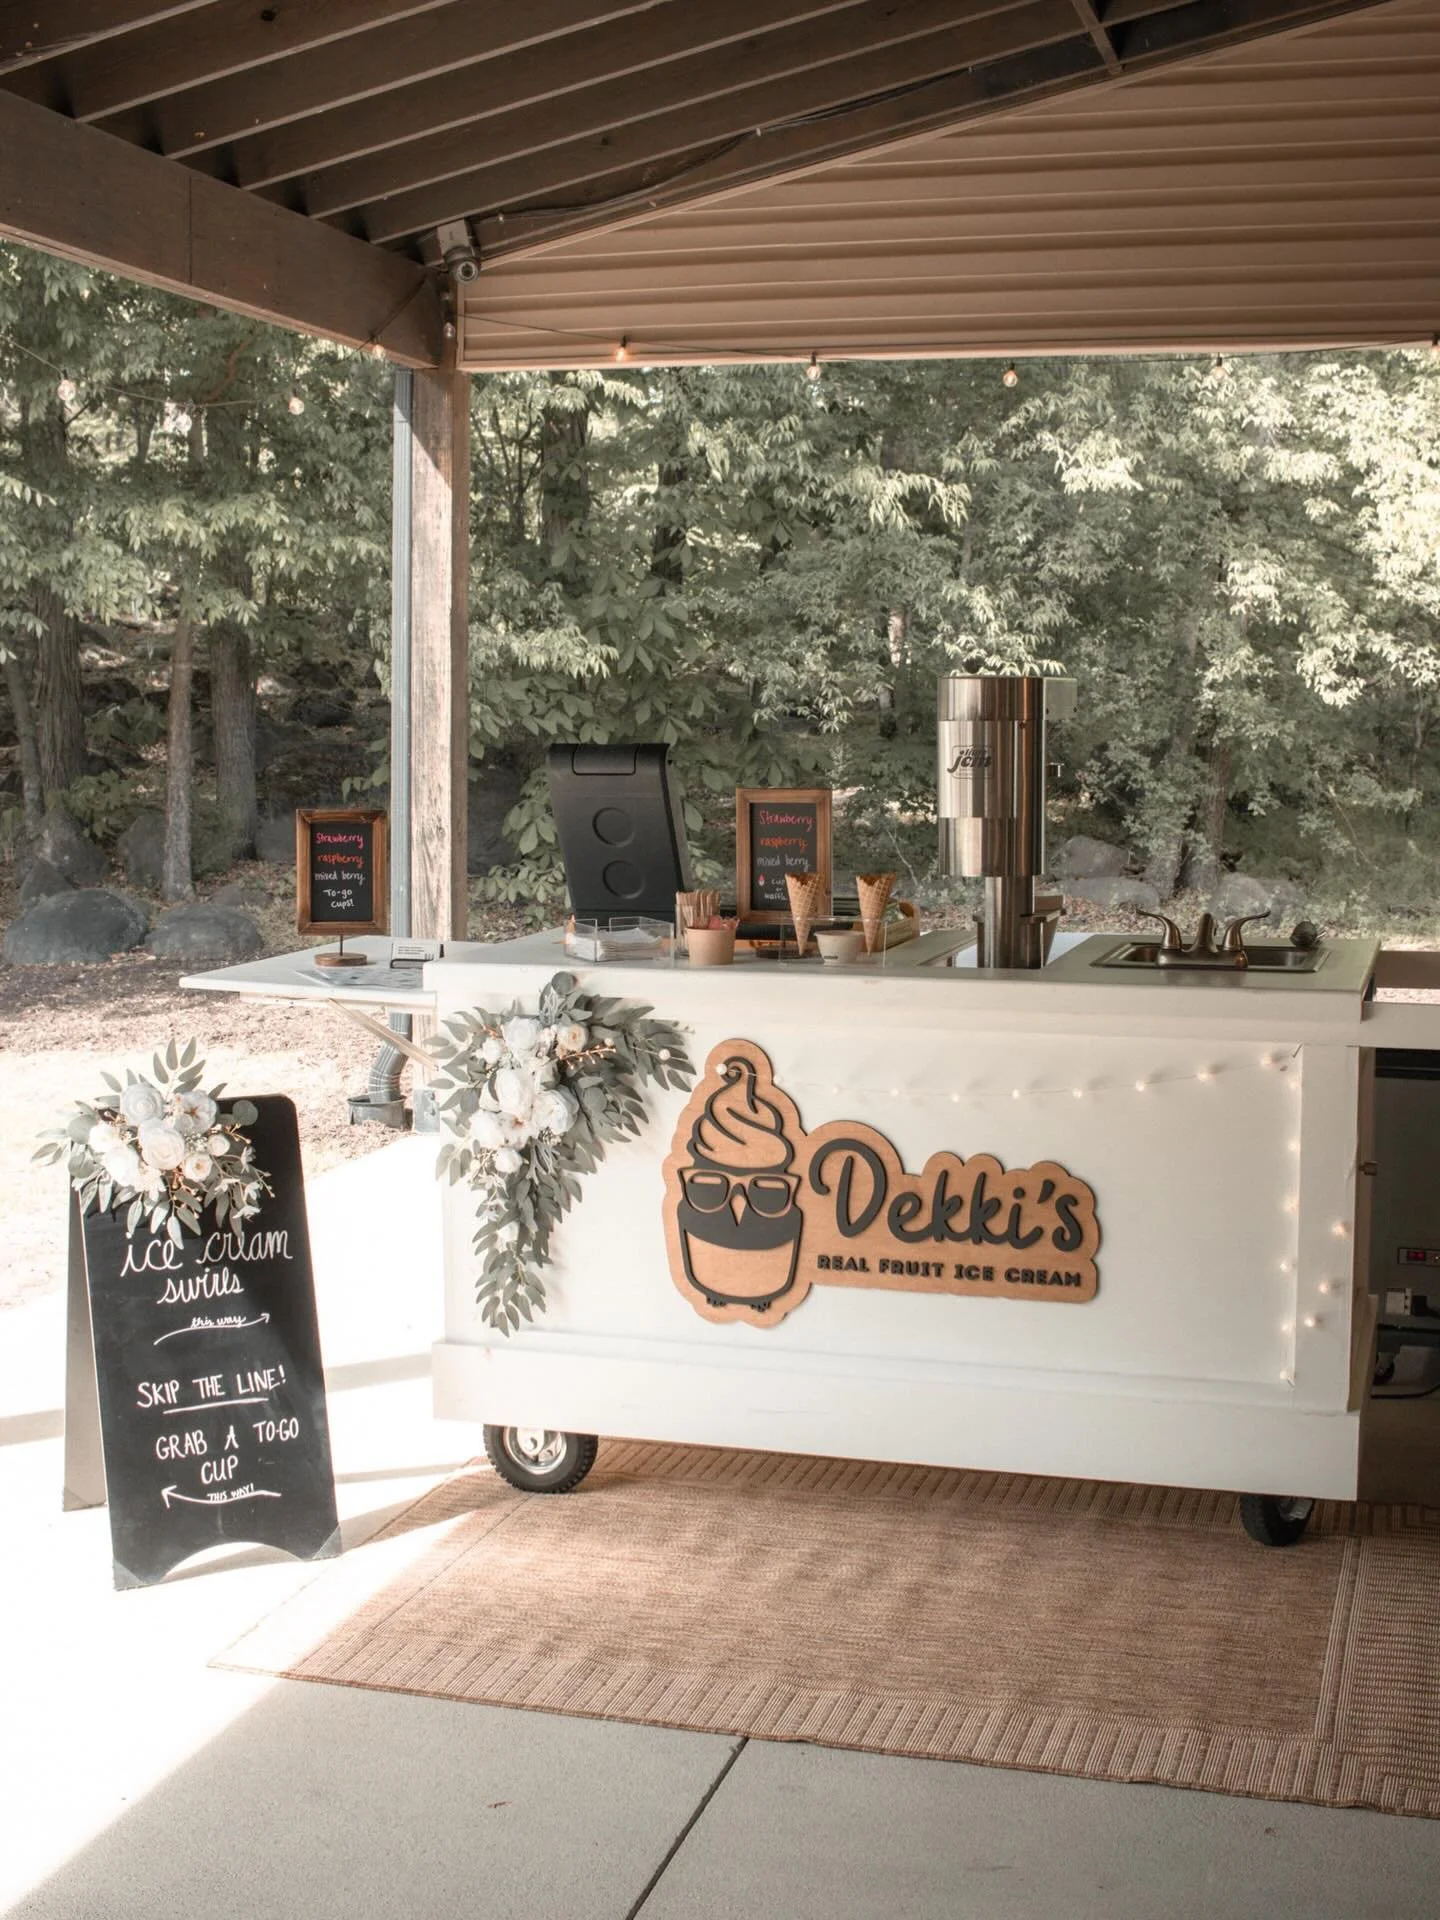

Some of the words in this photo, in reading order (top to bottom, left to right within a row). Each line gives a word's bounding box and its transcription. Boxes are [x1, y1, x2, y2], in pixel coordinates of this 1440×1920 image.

[317, 853, 364, 869] raspberry
[757, 856, 780, 866] mixed
[785, 853, 809, 872] berry
[315, 871, 338, 881] mixed
[341, 870, 365, 886] berry
[809, 1137, 1084, 1252] Dekki's
[120, 1233, 183, 1276] ice
[196, 1230, 293, 1264] cream
[157, 1267, 244, 1304] swirls
[817, 1255, 871, 1273] REAL
[880, 1258, 945, 1278] FRUIT
[955, 1263, 994, 1282] ICE
[1004, 1266, 1081, 1287] CREAM
[189, 1316, 214, 1328] this
[216, 1314, 247, 1328] way
[137, 1380, 180, 1408] SKIP
[193, 1374, 224, 1399] THE
[236, 1365, 286, 1395] LINE!
[155, 1429, 208, 1460] GRAB
[224, 1424, 239, 1450] A
[252, 1417, 299, 1443] TO-GO
[200, 1455, 239, 1485] CUP
[206, 1490, 228, 1502] THIS
[230, 1483, 254, 1499] WAY!
